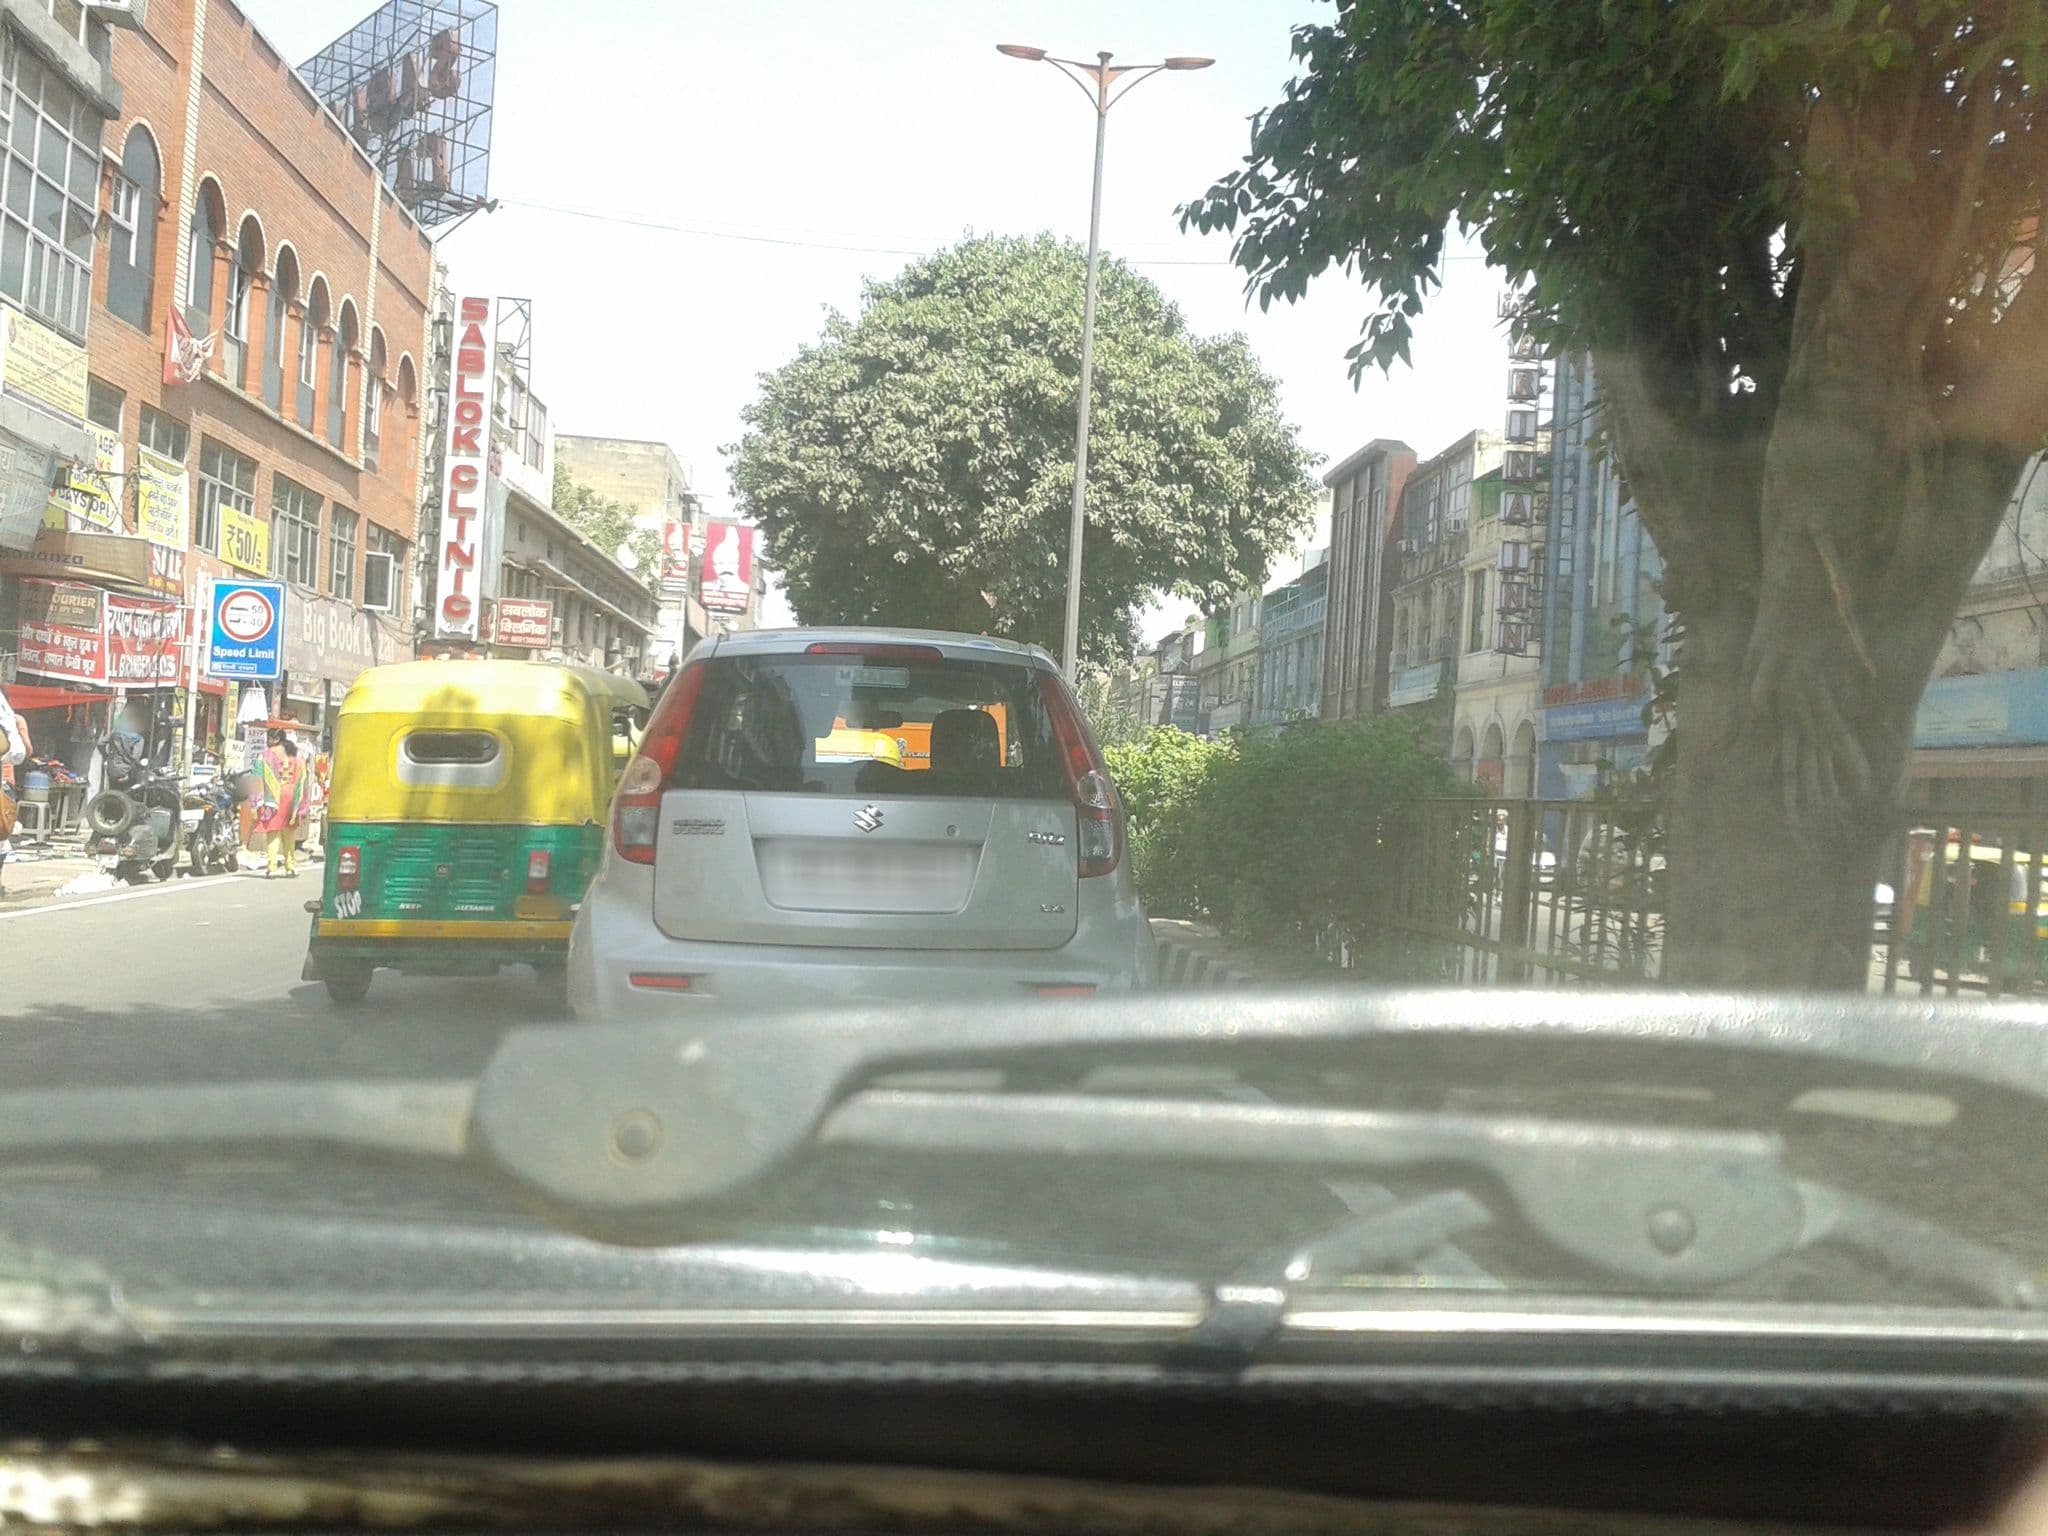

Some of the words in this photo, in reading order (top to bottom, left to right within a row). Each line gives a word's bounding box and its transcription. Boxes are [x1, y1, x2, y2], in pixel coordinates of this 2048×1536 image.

[452, 297, 489, 456] SABLOK
[442, 464, 479, 619] CLINIC
[250, 618, 263, 627] 40
[251, 605, 264, 614] 50
[303, 602, 325, 656] Big
[329, 606, 360, 655] Book
[213, 646, 246, 660] Speed
[248, 647, 275, 660] Limit
[334, 890, 362, 920] STOP
